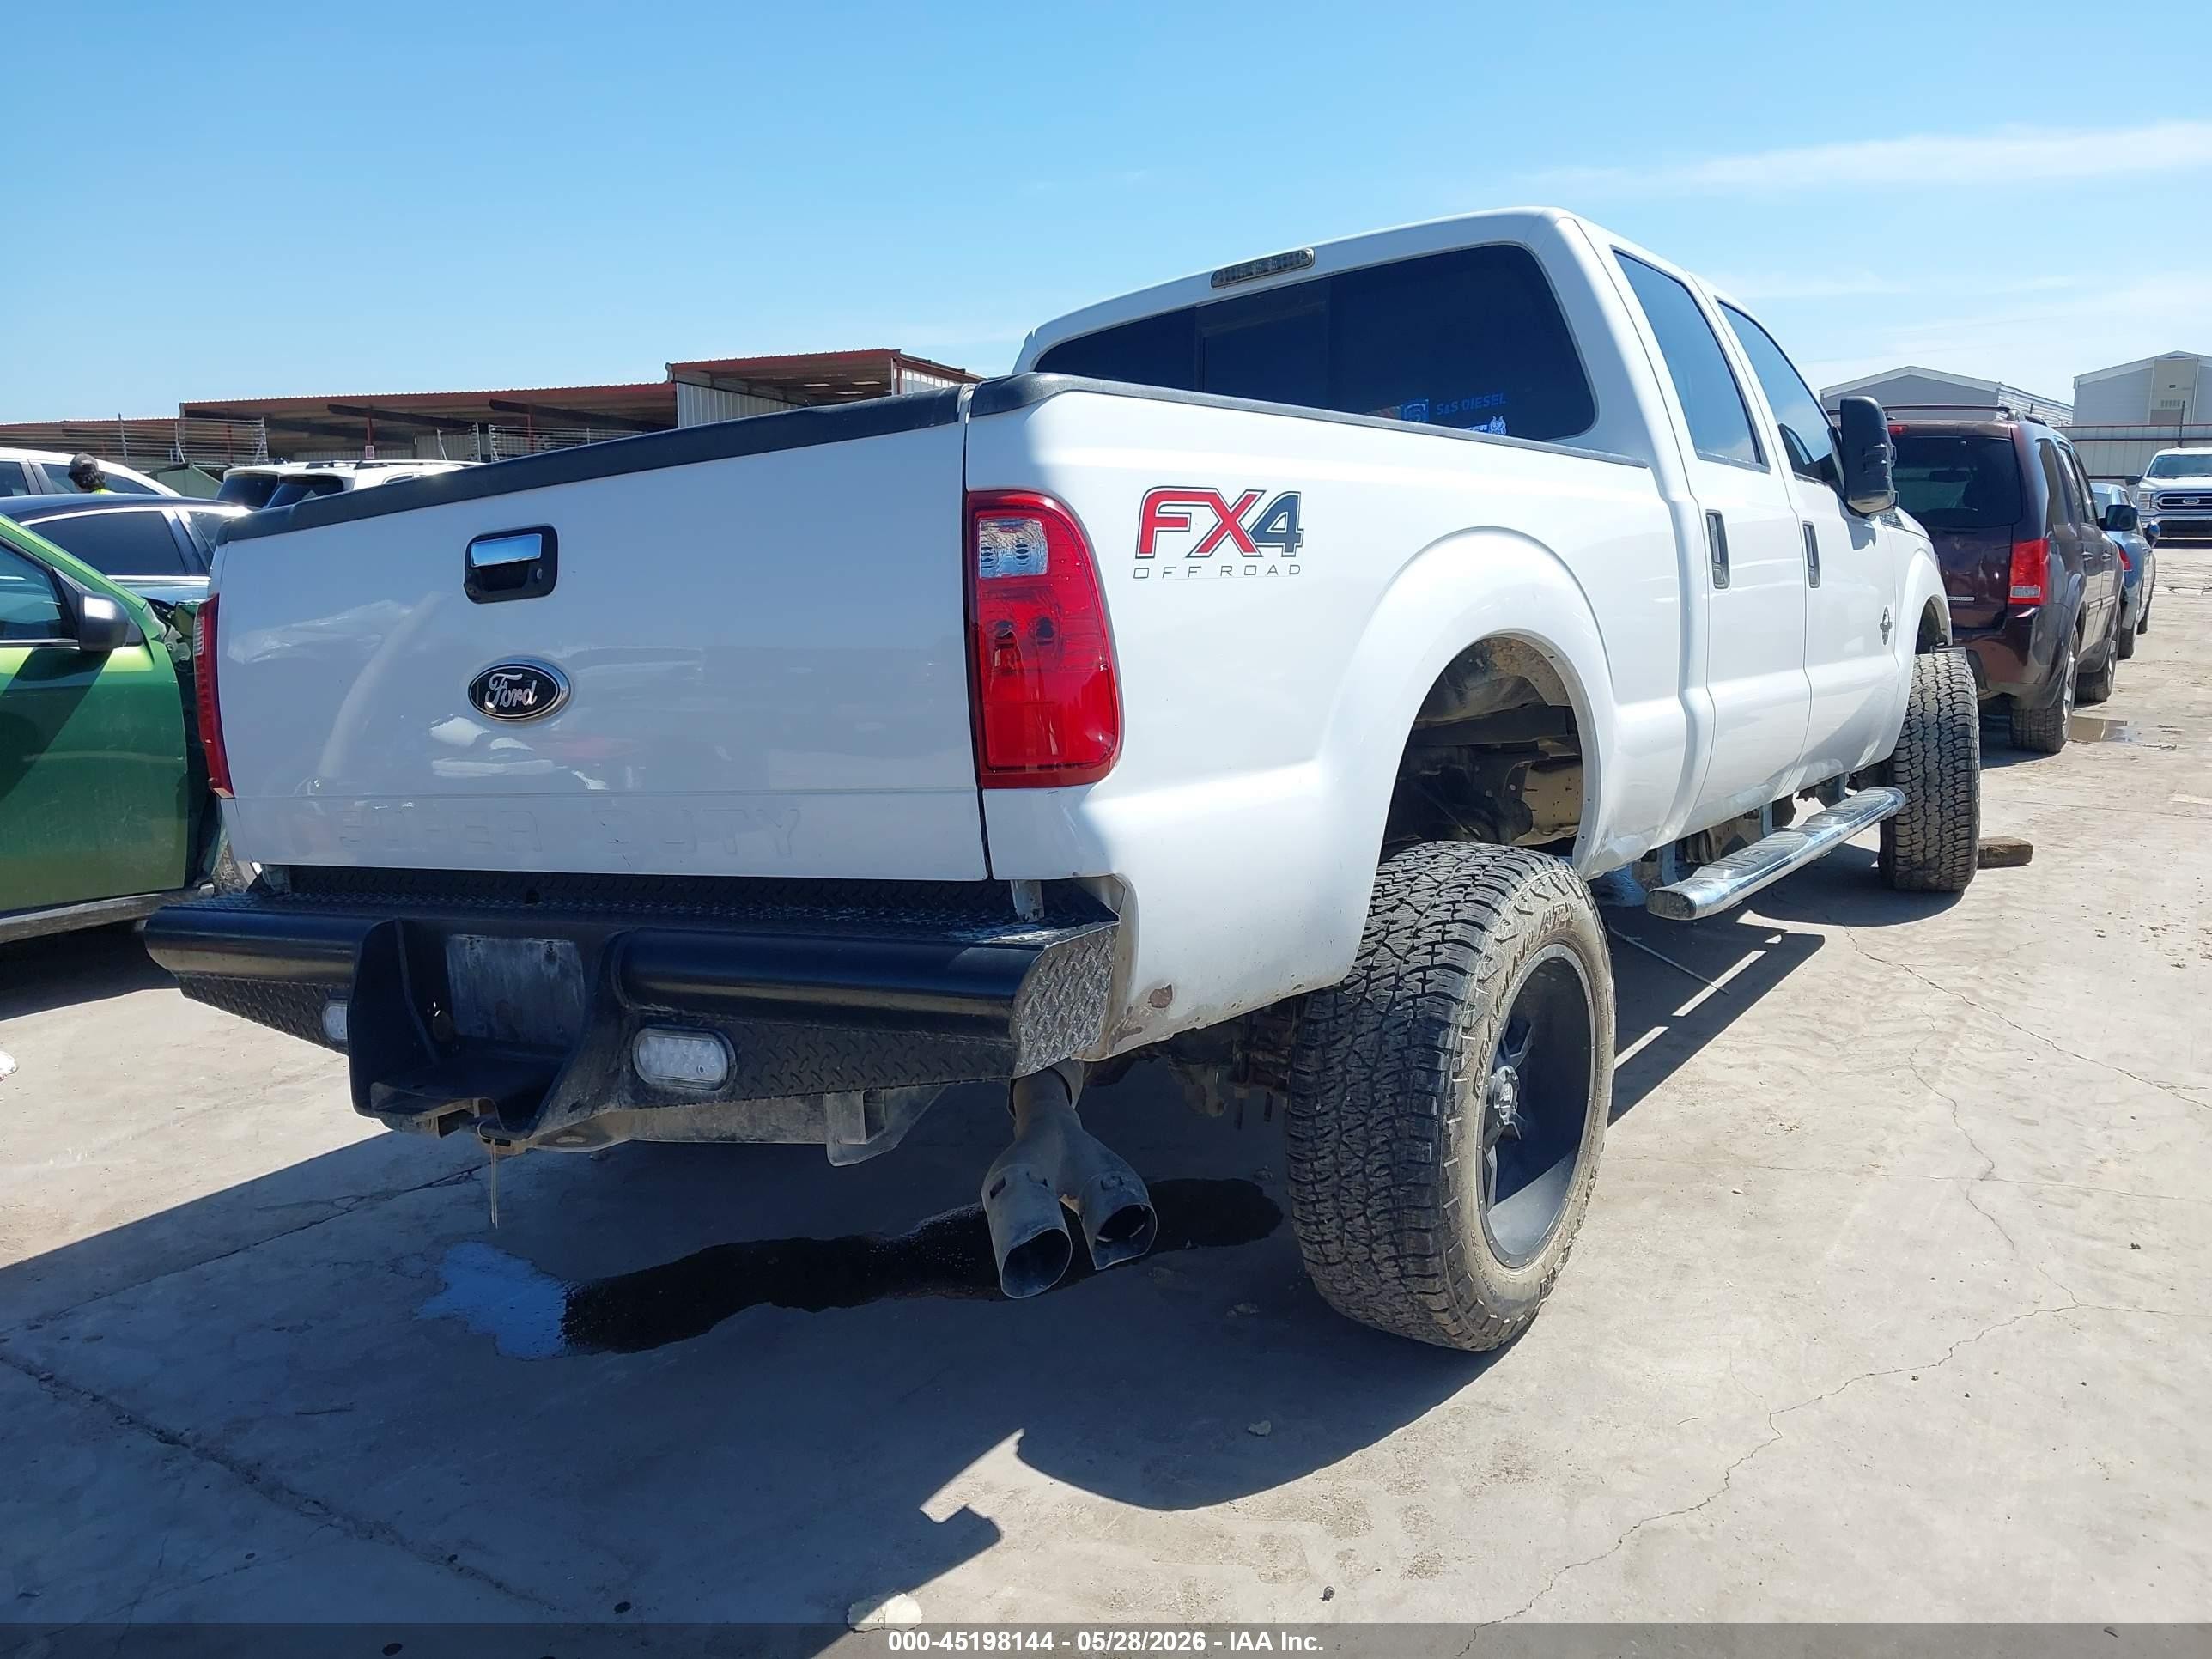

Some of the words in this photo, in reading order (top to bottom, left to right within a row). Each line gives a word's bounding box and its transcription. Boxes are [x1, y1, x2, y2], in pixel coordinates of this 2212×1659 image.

[1462, 392, 1507, 412] DIESEL
[1135, 485, 1304, 559] FX4
[1133, 565, 1202, 580] OFF
[1220, 564, 1302, 576] ROAD
[484, 673, 538, 713] Ford
